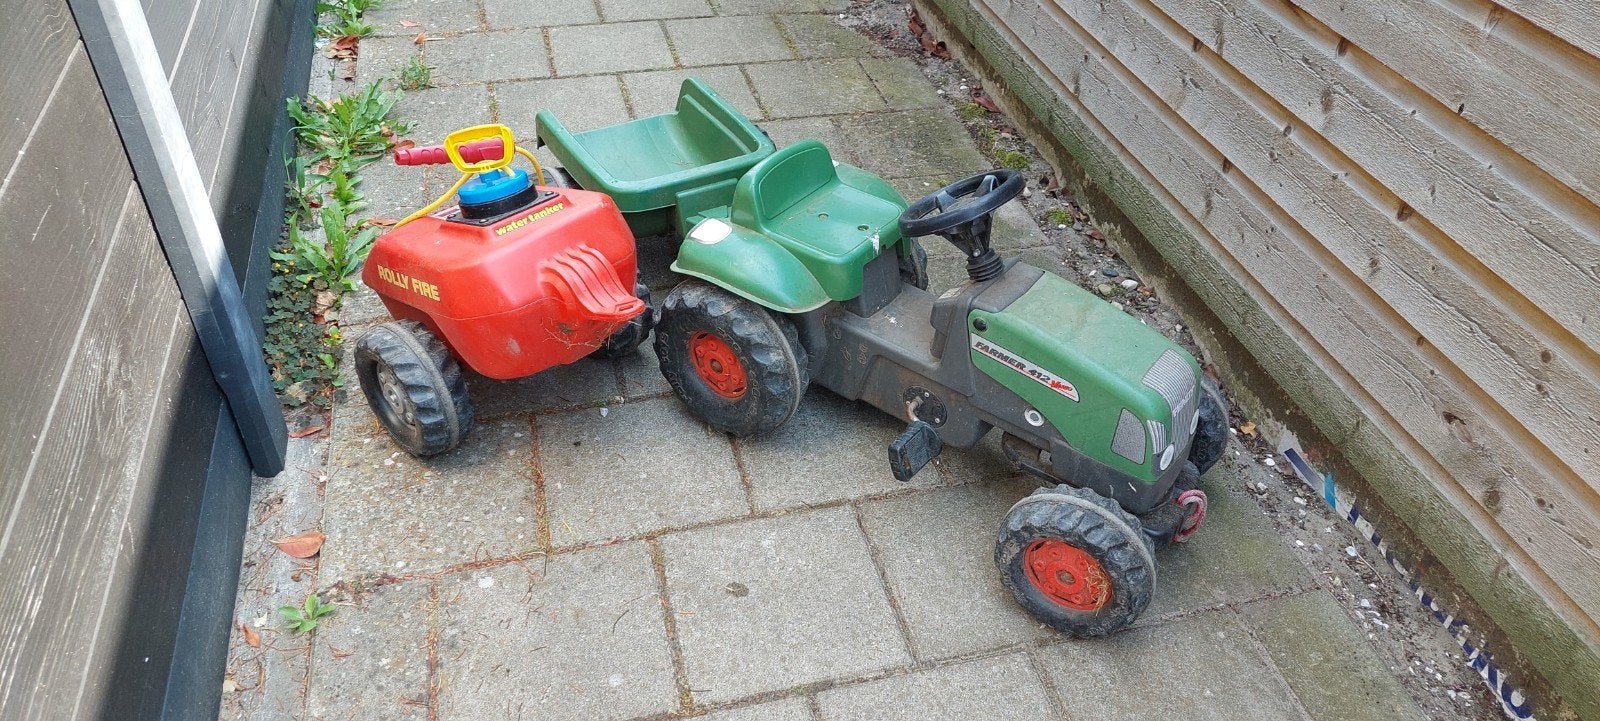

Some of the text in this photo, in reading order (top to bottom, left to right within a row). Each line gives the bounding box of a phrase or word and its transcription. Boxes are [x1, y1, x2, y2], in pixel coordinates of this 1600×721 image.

[495, 202, 565, 236] water tanker
[377, 264, 441, 301] ROLLY FIRE
[975, 341, 1027, 371] FARMER
[1028, 368, 1051, 384] 412
